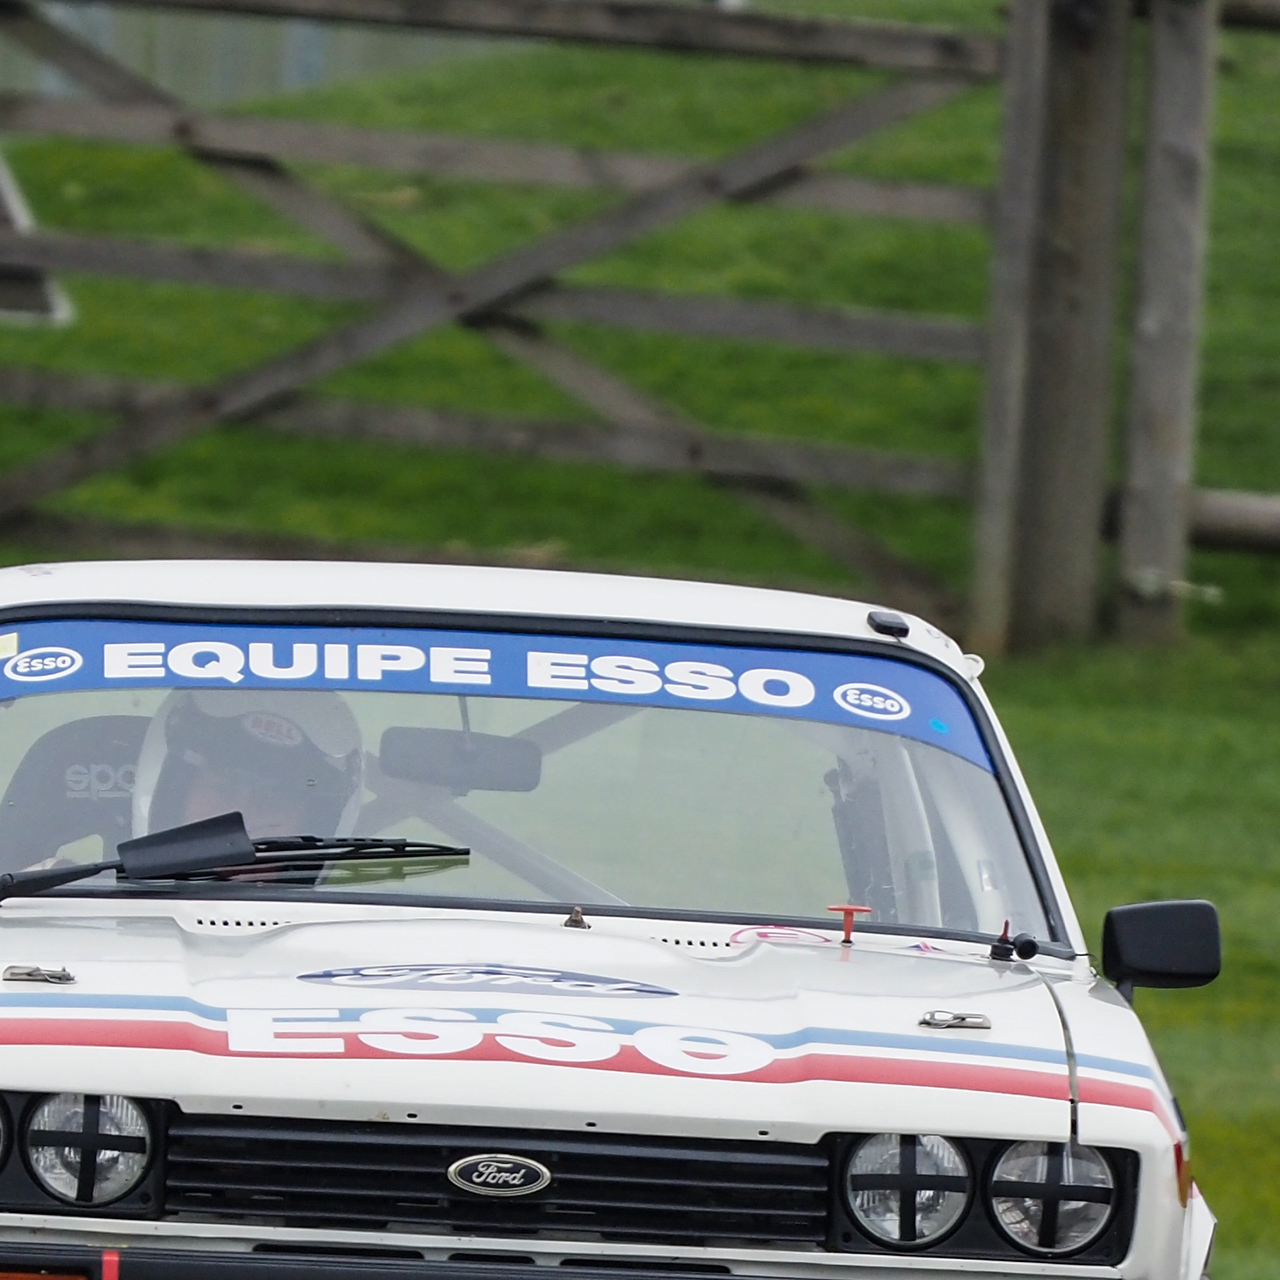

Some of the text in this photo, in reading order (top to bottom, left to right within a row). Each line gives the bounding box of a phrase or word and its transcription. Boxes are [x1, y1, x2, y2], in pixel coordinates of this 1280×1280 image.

[103, 641, 816, 707] EQUIPE ESSO
[65, 763, 137, 801] spa
[225, 1006, 777, 1075] ESSO
[471, 1161, 527, 1185] Ford
